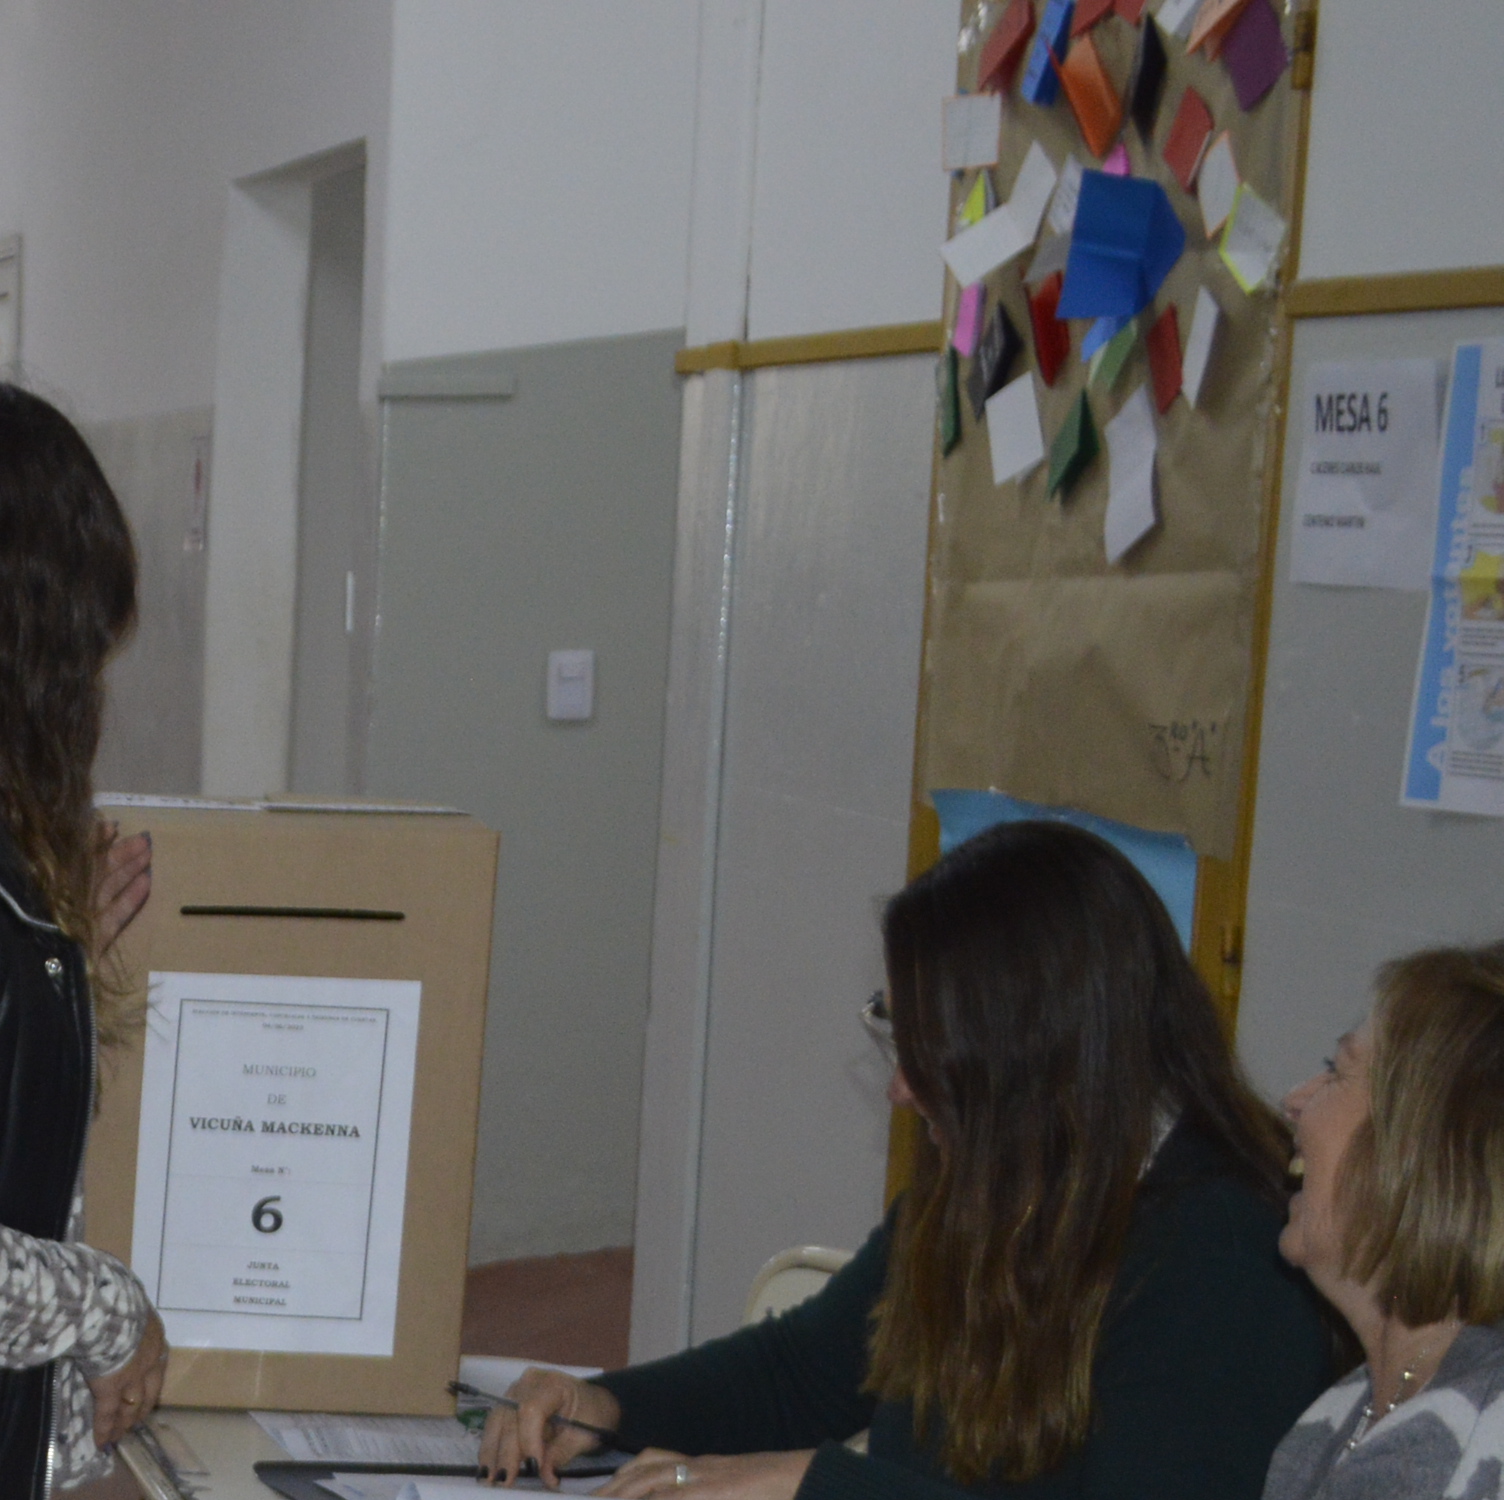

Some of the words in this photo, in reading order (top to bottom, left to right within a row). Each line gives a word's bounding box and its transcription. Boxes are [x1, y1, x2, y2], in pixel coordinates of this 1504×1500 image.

[1314, 392, 1372, 433] MESA
[1377, 391, 1389, 433] 6
[242, 1063, 317, 1078] MUNICIPIO
[266, 1093, 287, 1105] DE
[189, 1116, 255, 1133] VICUÑA
[261, 1120, 361, 1138] MACKENNA
[251, 1164, 274, 1174] Mesa
[251, 1195, 283, 1233] 6
[247, 1260, 280, 1270] JUNTA
[232, 1277, 290, 1289] ELECTORAL
[233, 1294, 287, 1307] MUNICIPAL
